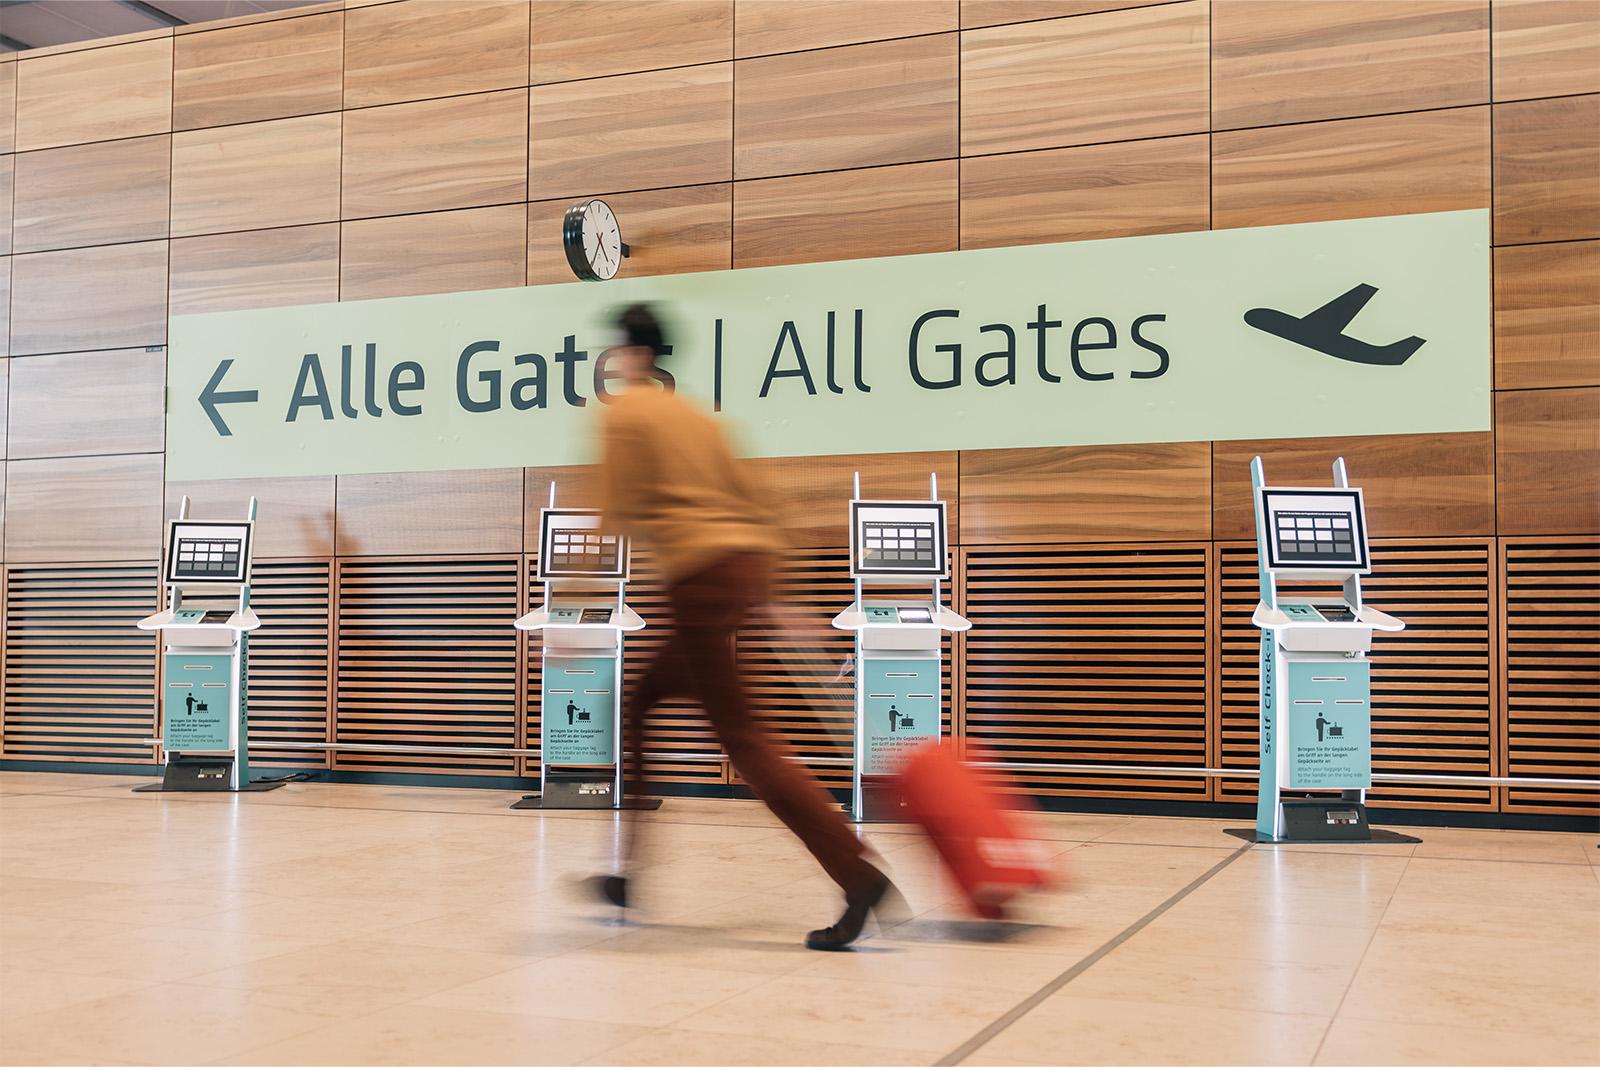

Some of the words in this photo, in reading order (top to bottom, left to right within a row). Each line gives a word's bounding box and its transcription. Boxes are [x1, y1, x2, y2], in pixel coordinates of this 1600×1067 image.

[285, 342, 425, 422] Alle
[759, 308, 872, 398] All
[908, 302, 1171, 391] Gates
